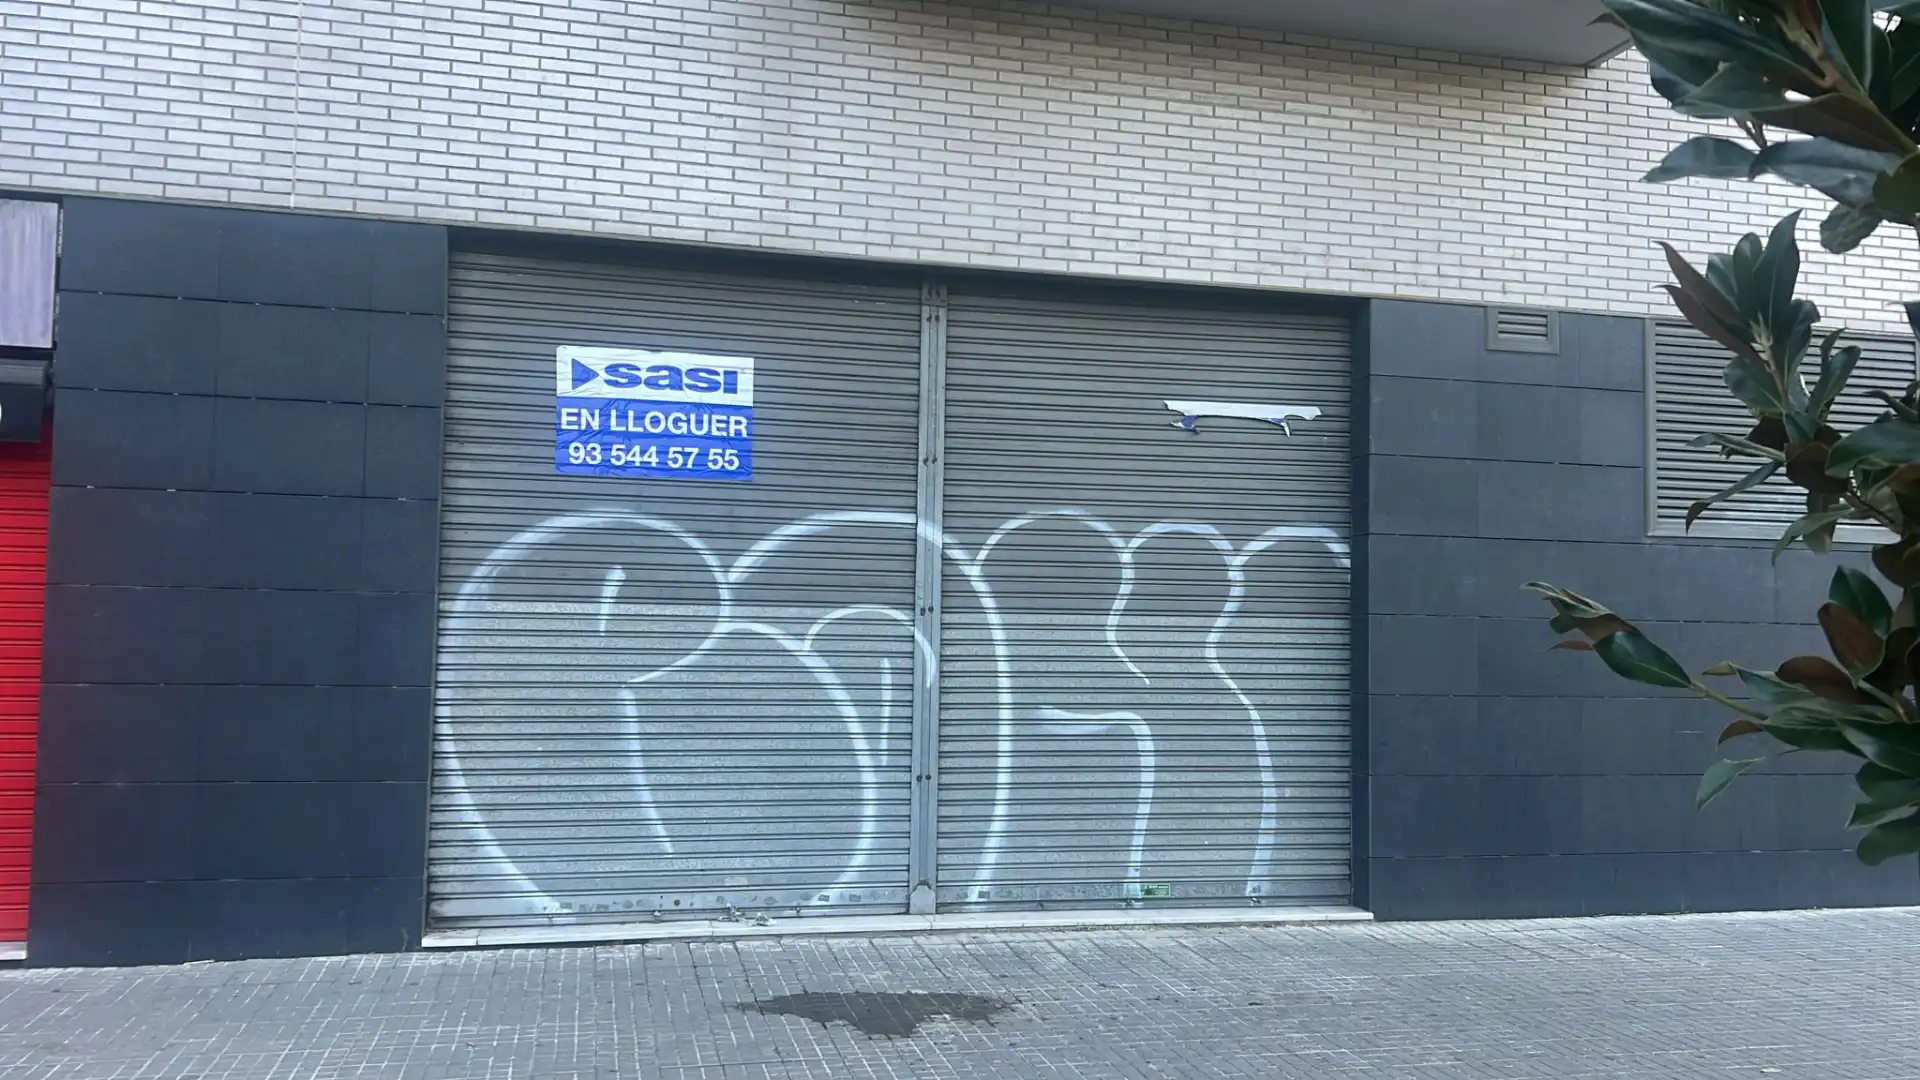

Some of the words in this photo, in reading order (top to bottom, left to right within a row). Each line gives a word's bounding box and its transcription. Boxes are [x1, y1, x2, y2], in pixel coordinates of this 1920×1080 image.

[603, 363, 738, 394] sasi
[560, 408, 600, 431] EN
[610, 409, 748, 437] LLOGUER
[568, 442, 602, 465] 93
[610, 444, 659, 467] 544
[667, 447, 699, 469] 57
[707, 448, 740, 470] 55
